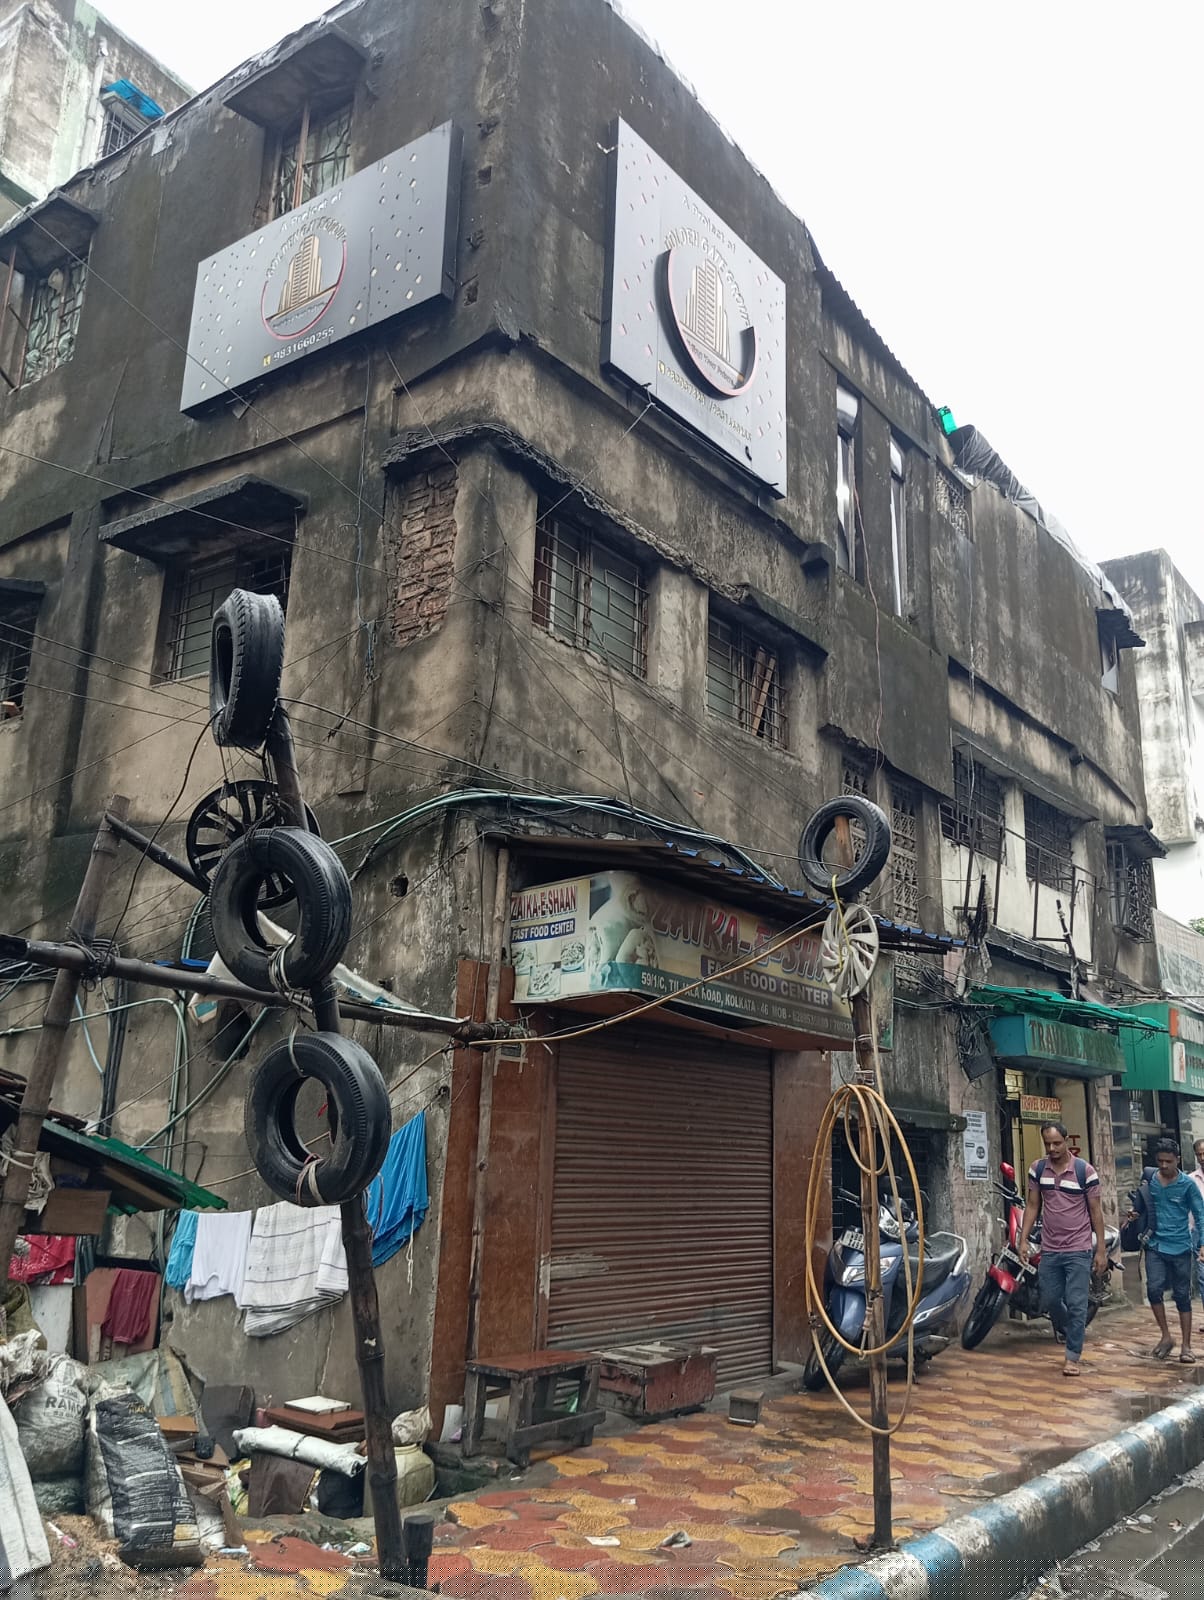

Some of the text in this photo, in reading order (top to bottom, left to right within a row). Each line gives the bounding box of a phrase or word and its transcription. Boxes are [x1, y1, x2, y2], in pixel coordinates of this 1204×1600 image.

[701, 236, 727, 273] GATE
[511, 885, 577, 923] ZAIKA-E-SHAAN
[512, 919, 575, 941] FAST FOOD CENTER
[742, 970, 777, 994] FOOD
[780, 980, 829, 1006] CENTER
